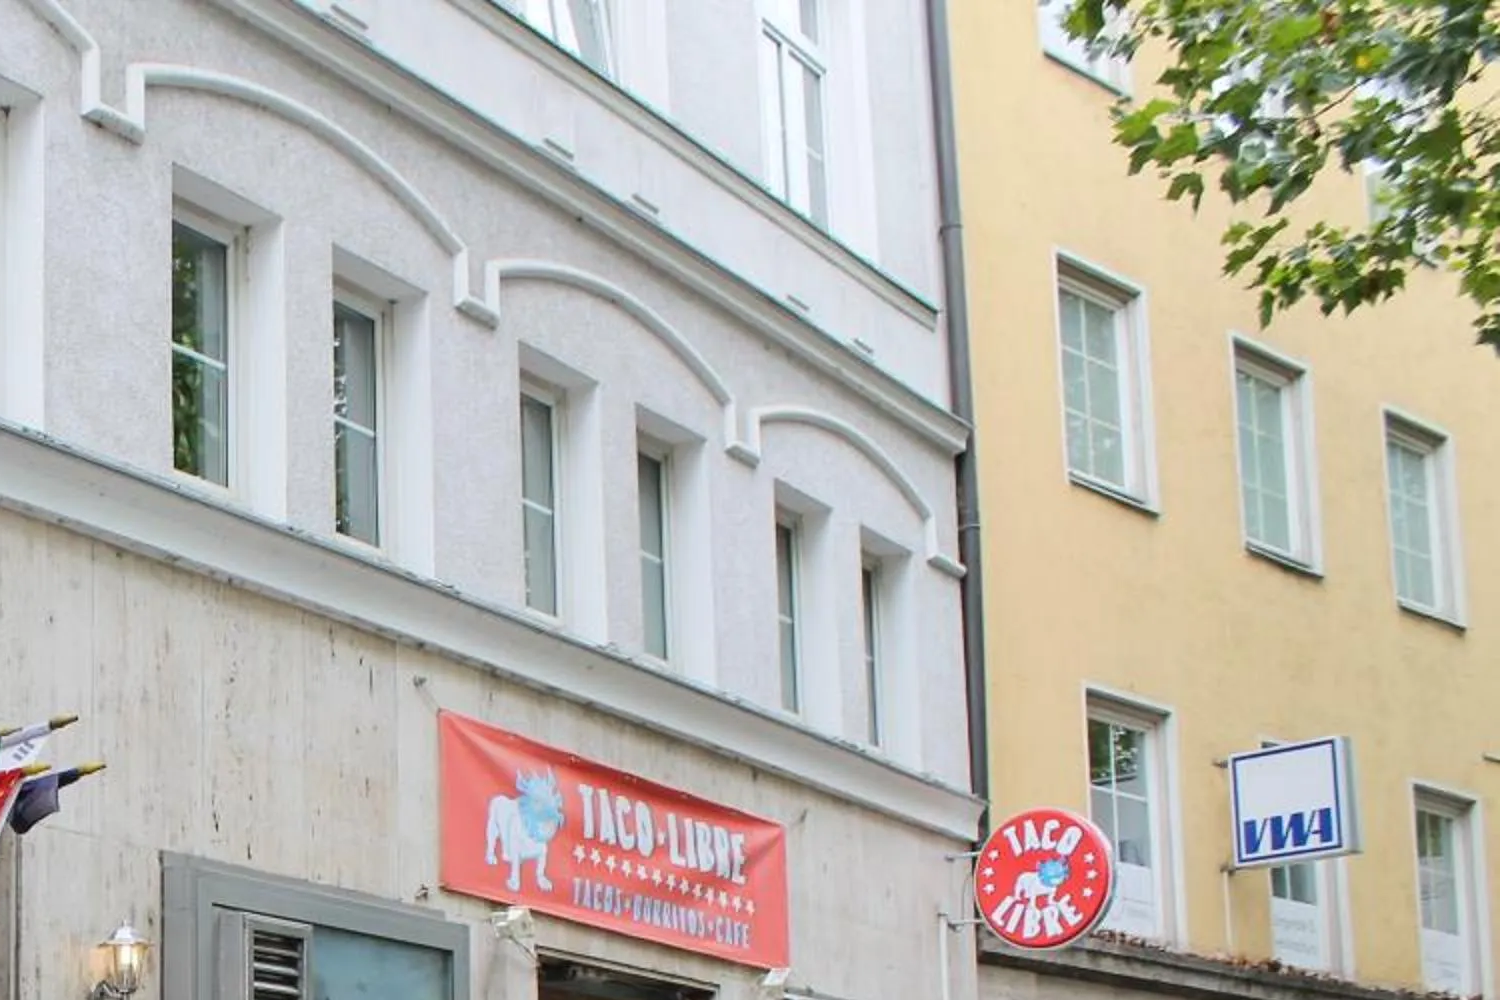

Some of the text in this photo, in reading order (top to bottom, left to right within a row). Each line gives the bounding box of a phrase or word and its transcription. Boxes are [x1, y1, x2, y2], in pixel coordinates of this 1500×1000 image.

[578, 783, 747, 885] TACO LIBRE
[1003, 818, 1084, 857] TACO
[1243, 807, 1333, 855] VWA
[991, 893, 1084, 939] LIBRE
